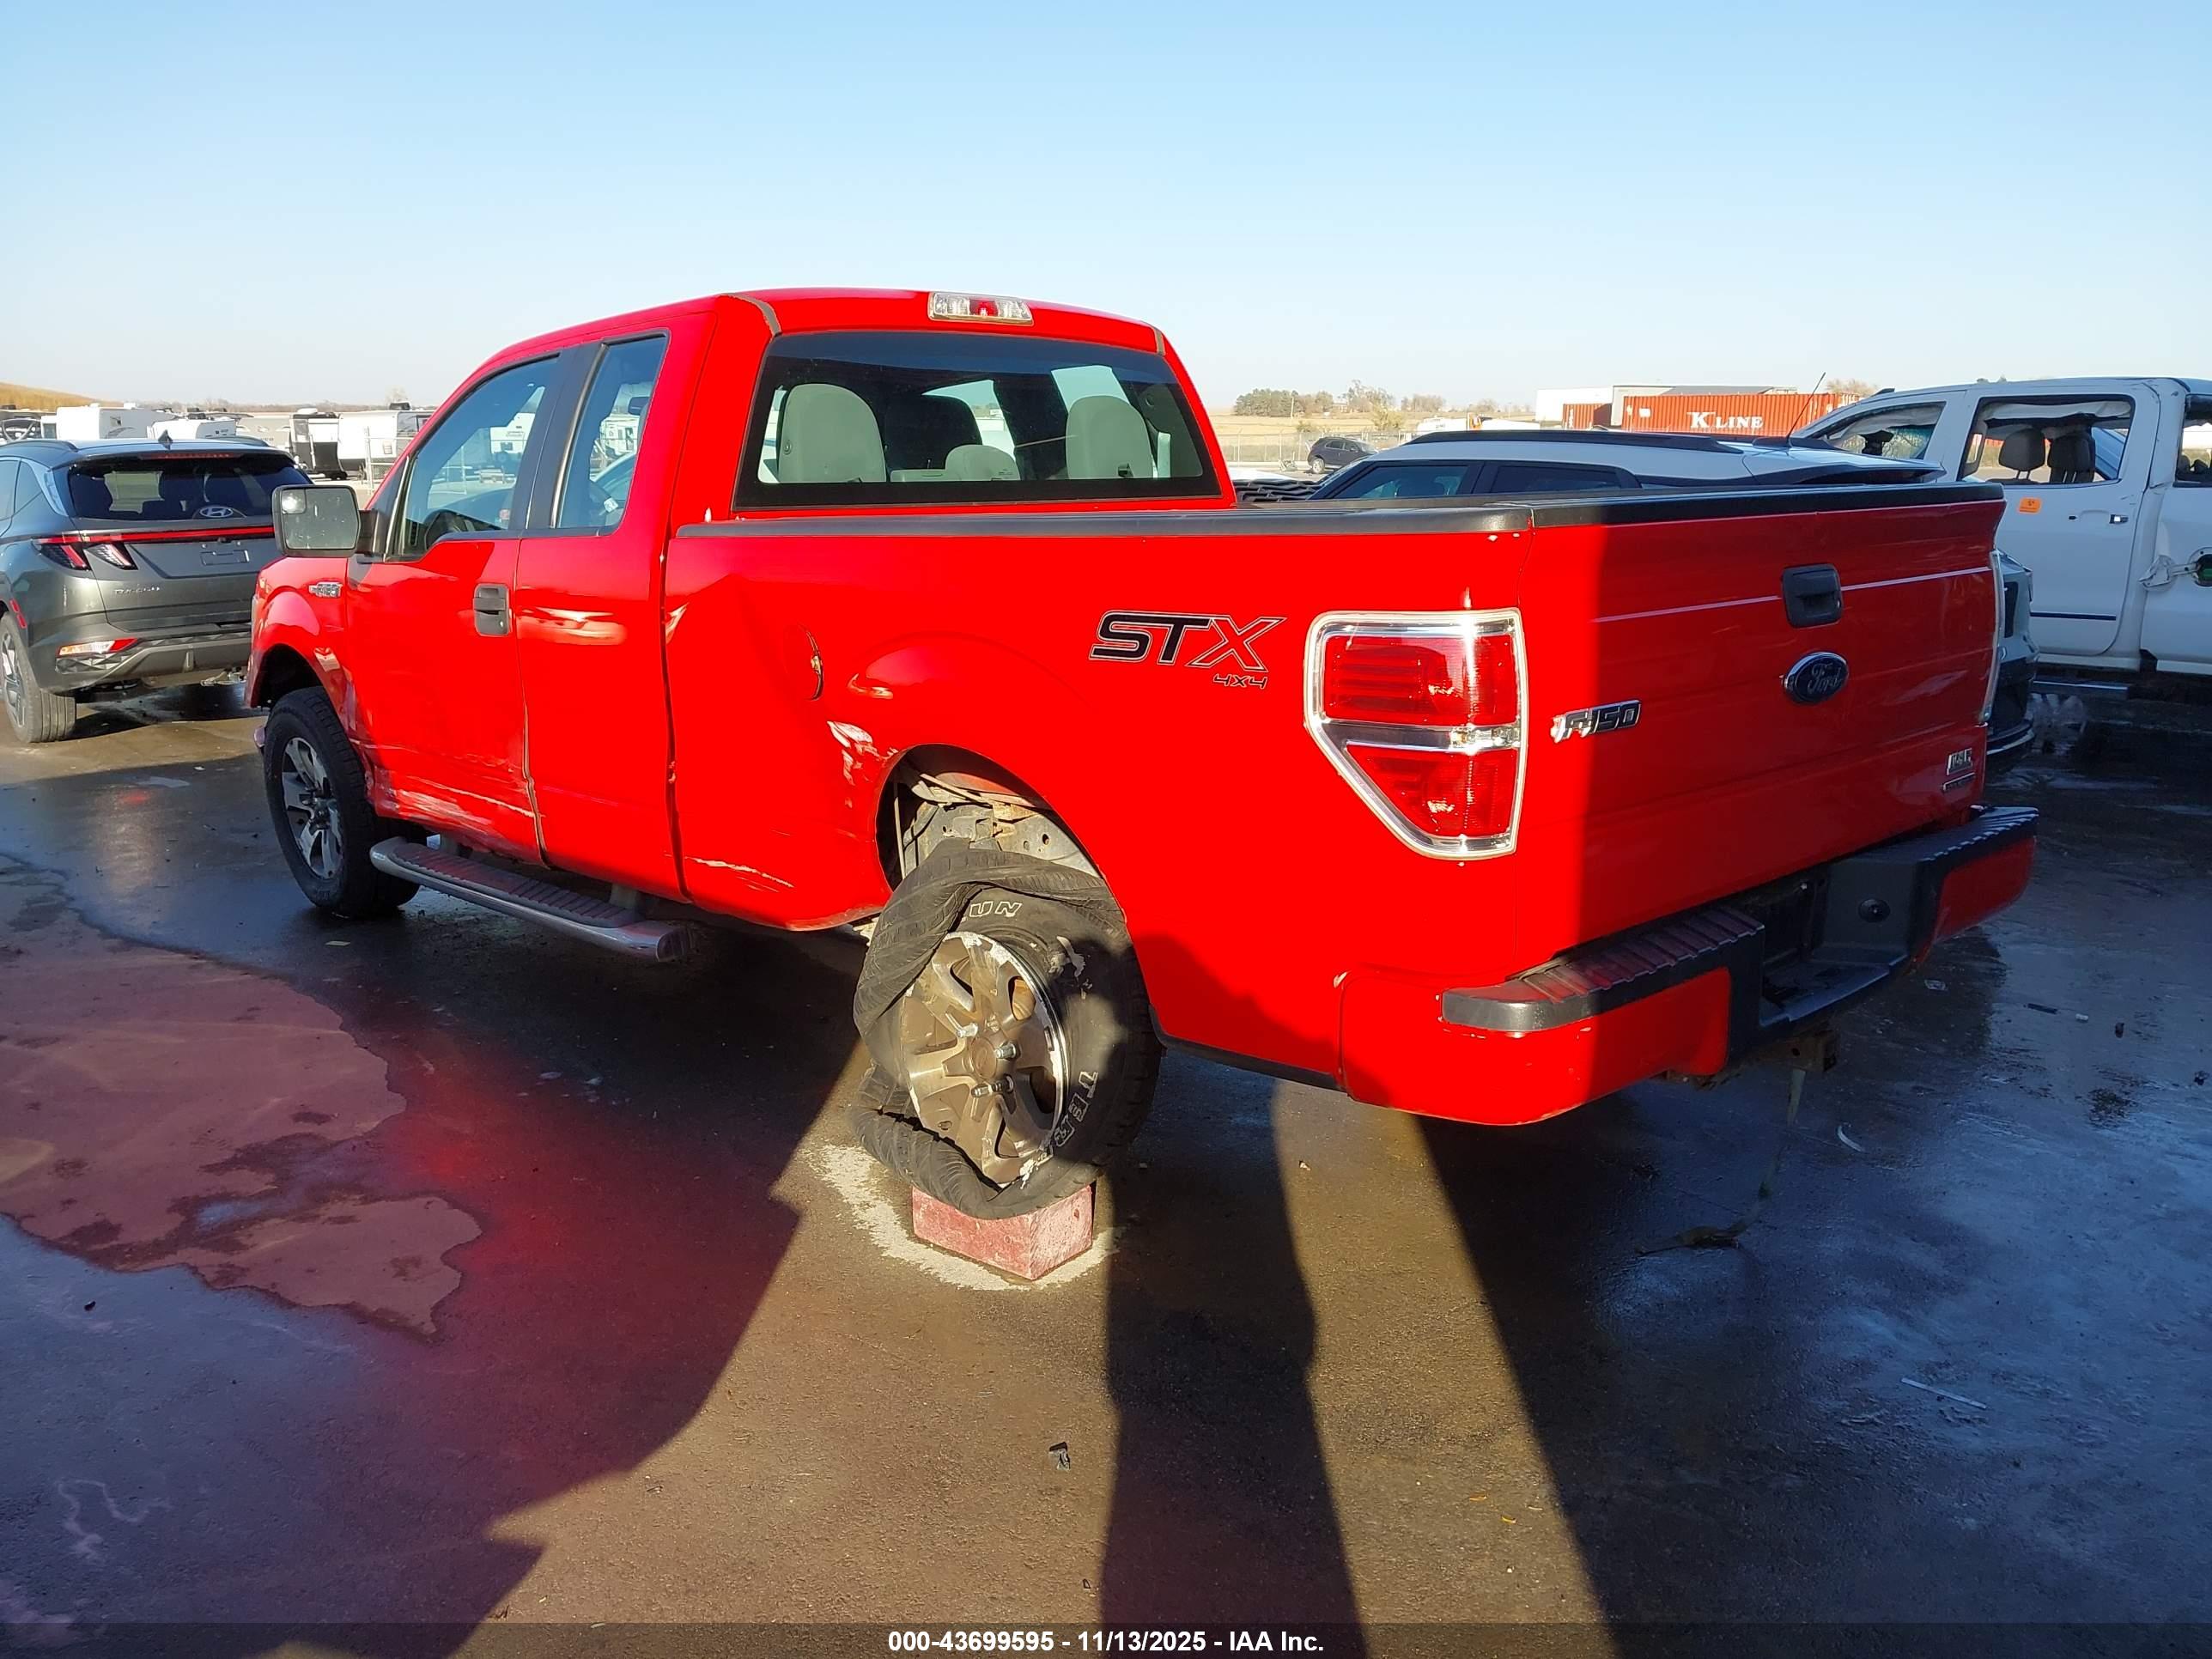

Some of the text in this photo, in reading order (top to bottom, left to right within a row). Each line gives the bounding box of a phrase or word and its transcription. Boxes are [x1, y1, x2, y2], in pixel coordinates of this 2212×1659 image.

[1686, 412, 1763, 429] K LINE
[1089, 610, 1287, 672] STX
[1807, 662, 1843, 695] Ford
